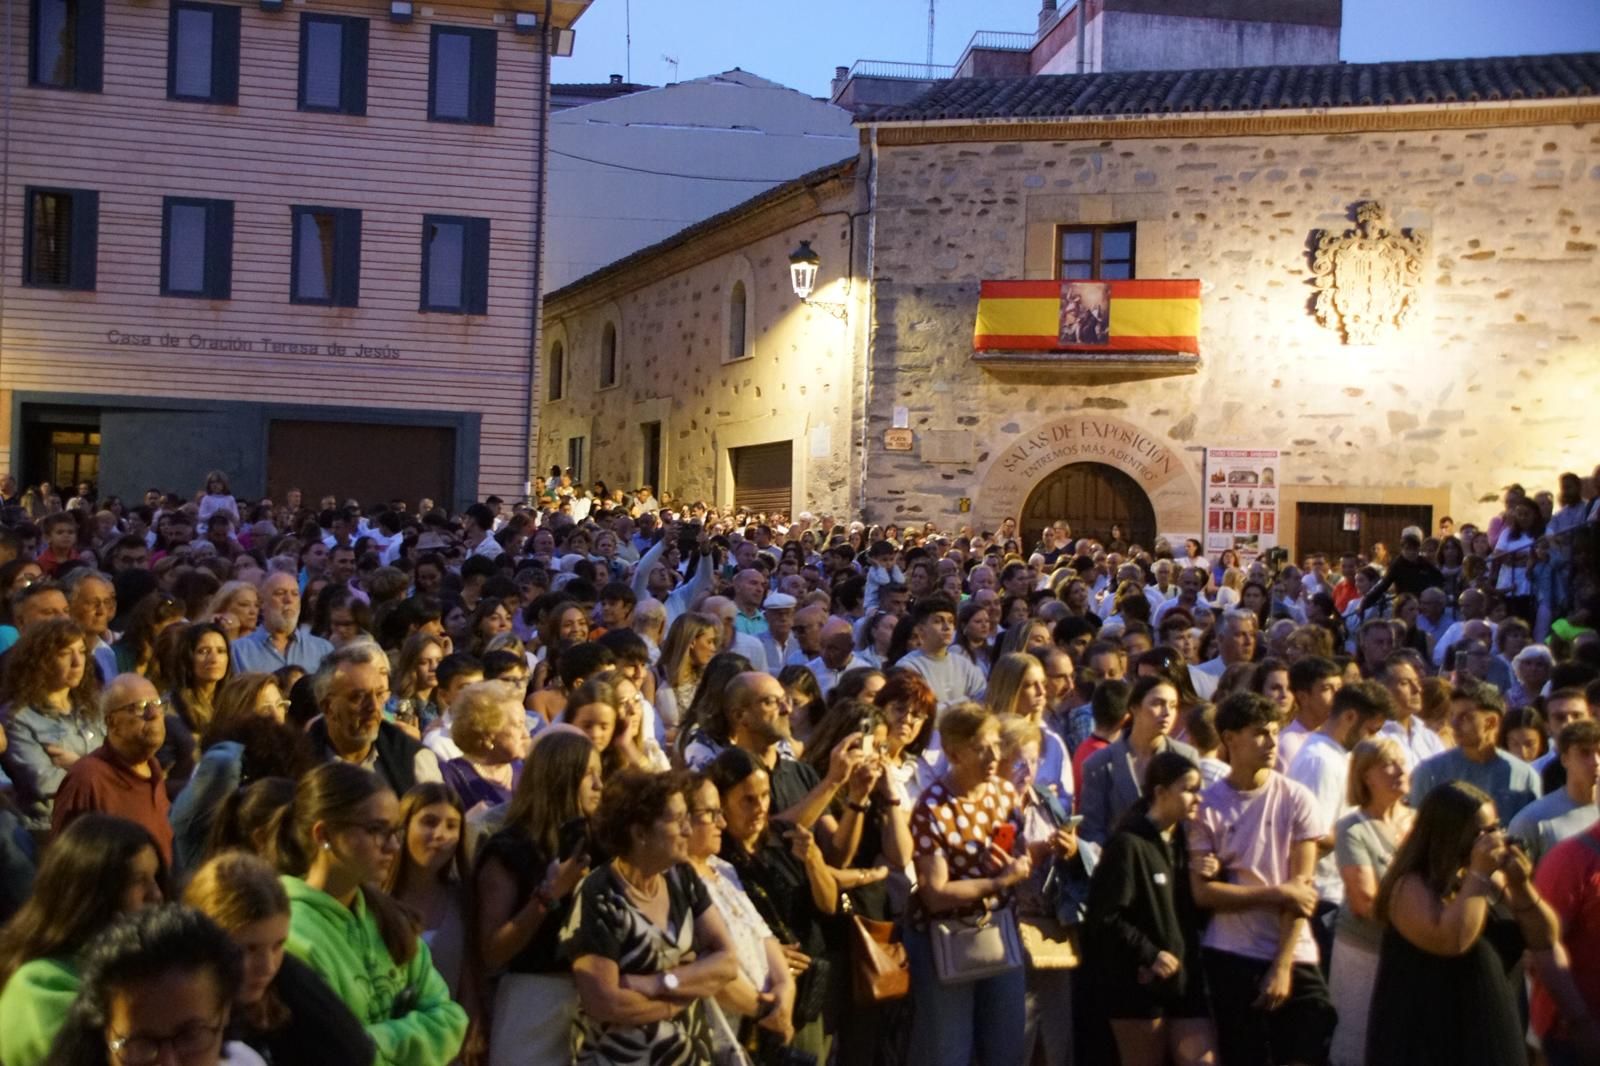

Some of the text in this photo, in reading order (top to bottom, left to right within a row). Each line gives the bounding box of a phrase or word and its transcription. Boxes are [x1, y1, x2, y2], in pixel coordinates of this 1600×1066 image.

[107, 329, 400, 359] Casa de Oración Teresa de Jesús
[1003, 431, 1049, 473] SALAS
[1051, 423, 1073, 442] DE
